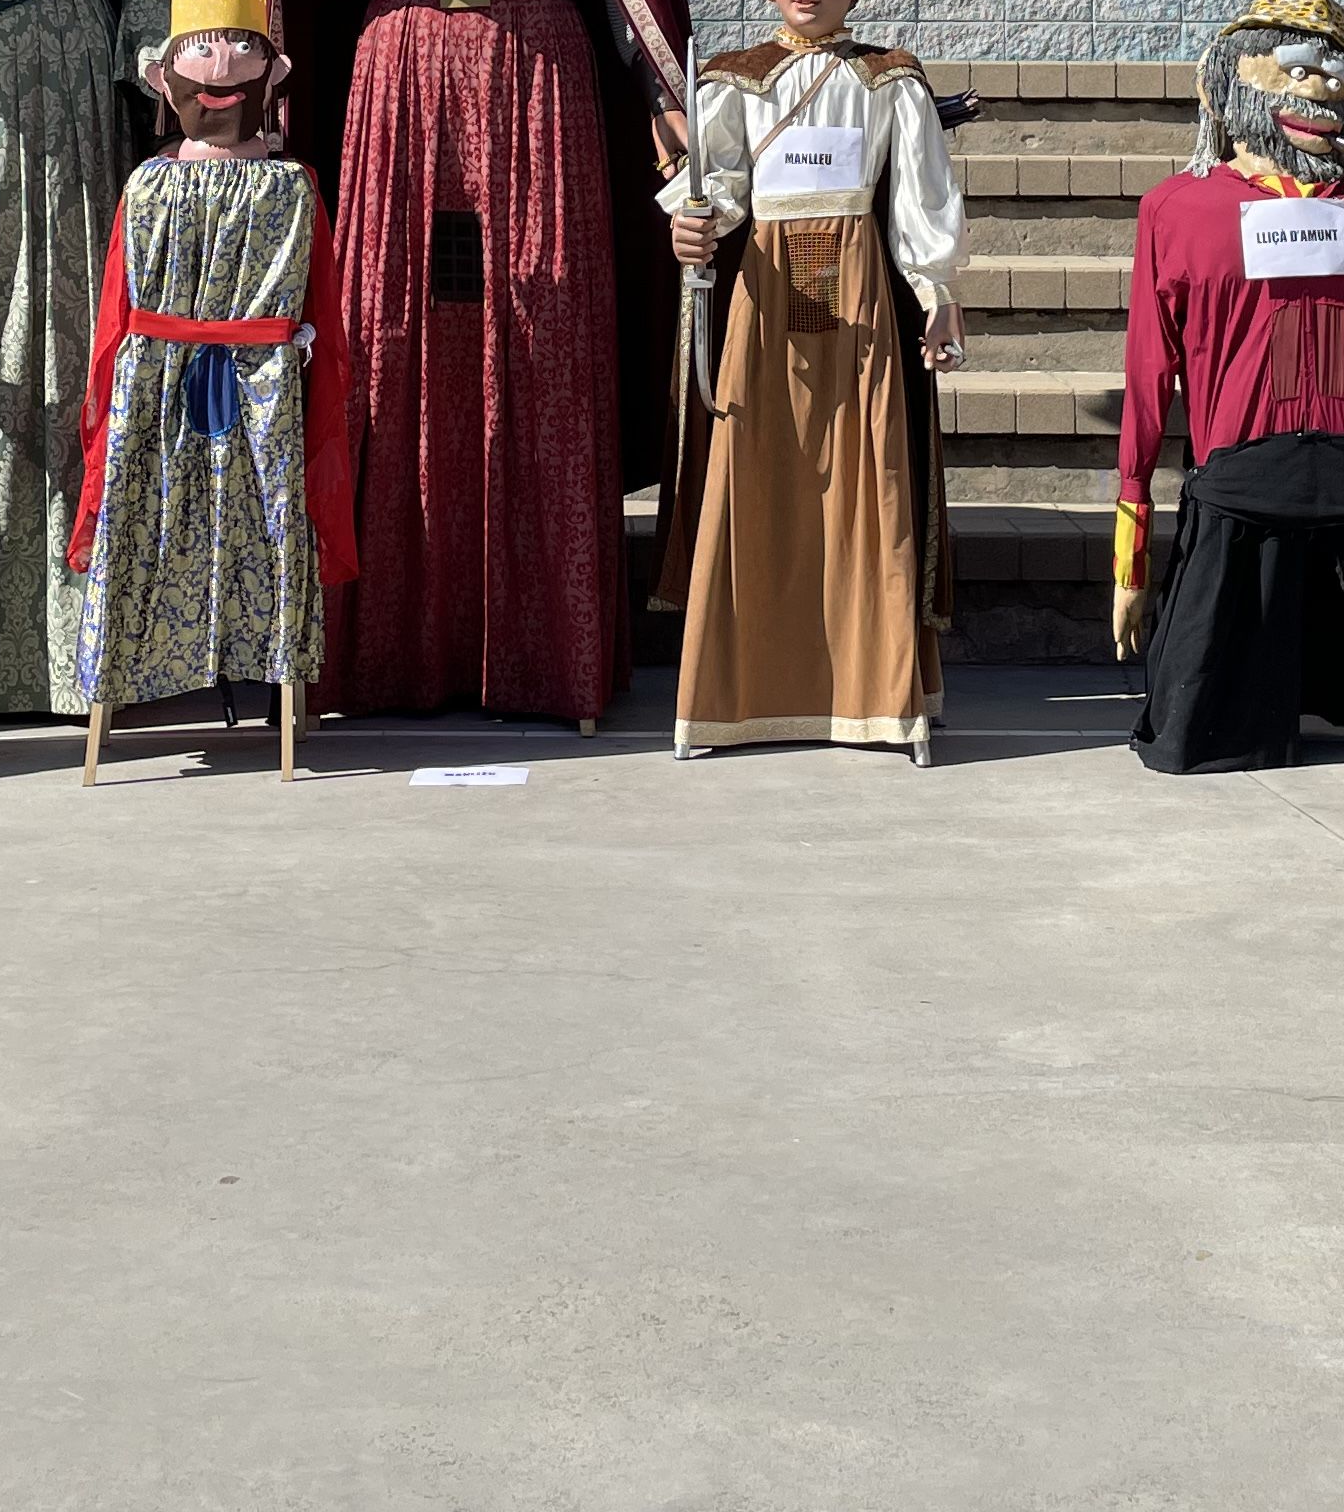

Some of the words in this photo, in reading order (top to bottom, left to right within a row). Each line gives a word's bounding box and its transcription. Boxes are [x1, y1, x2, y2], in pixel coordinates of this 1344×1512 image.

[785, 153, 832, 165] MANLLEU
[1256, 230, 1287, 245] LLIÇÀ
[1290, 229, 1338, 242] D'AMUNT
